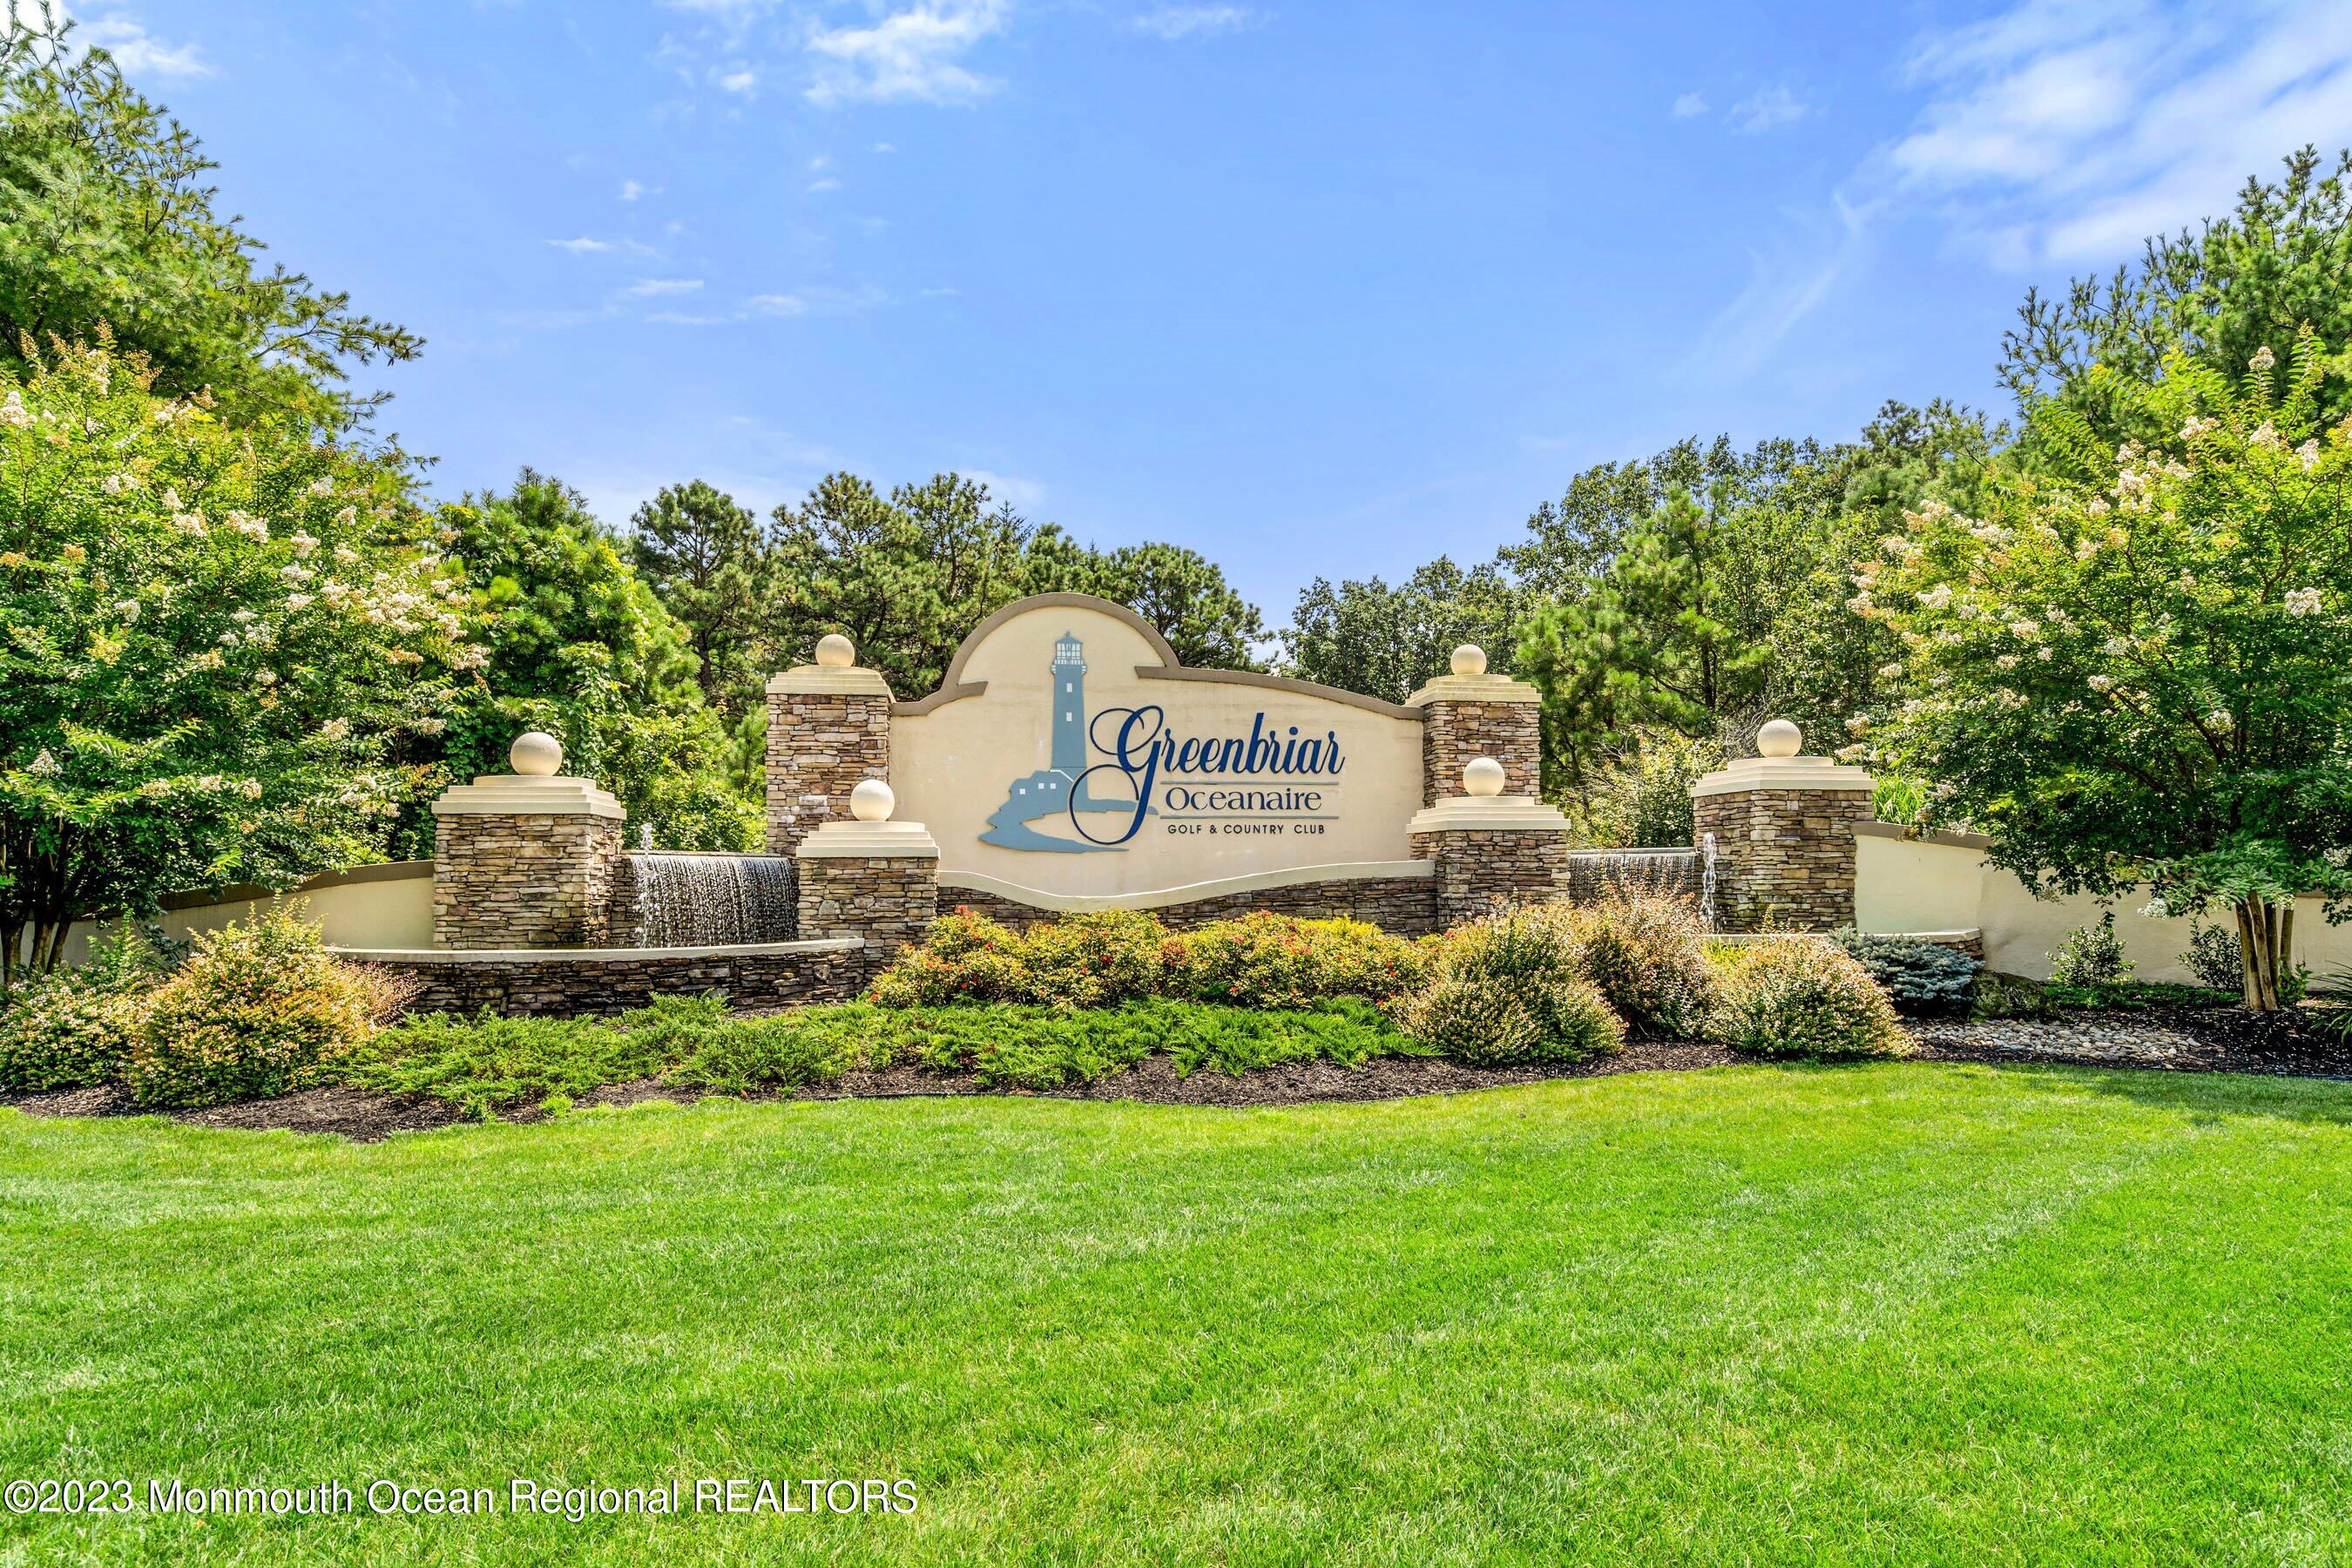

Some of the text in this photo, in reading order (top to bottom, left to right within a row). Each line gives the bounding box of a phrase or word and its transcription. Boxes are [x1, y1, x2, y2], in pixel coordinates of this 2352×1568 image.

[1069, 705, 1346, 846] Greenbriar
[1165, 787, 1322, 812] Oceanaire
[1167, 824, 1326, 835] GOLF & COUNTRY CLUB
